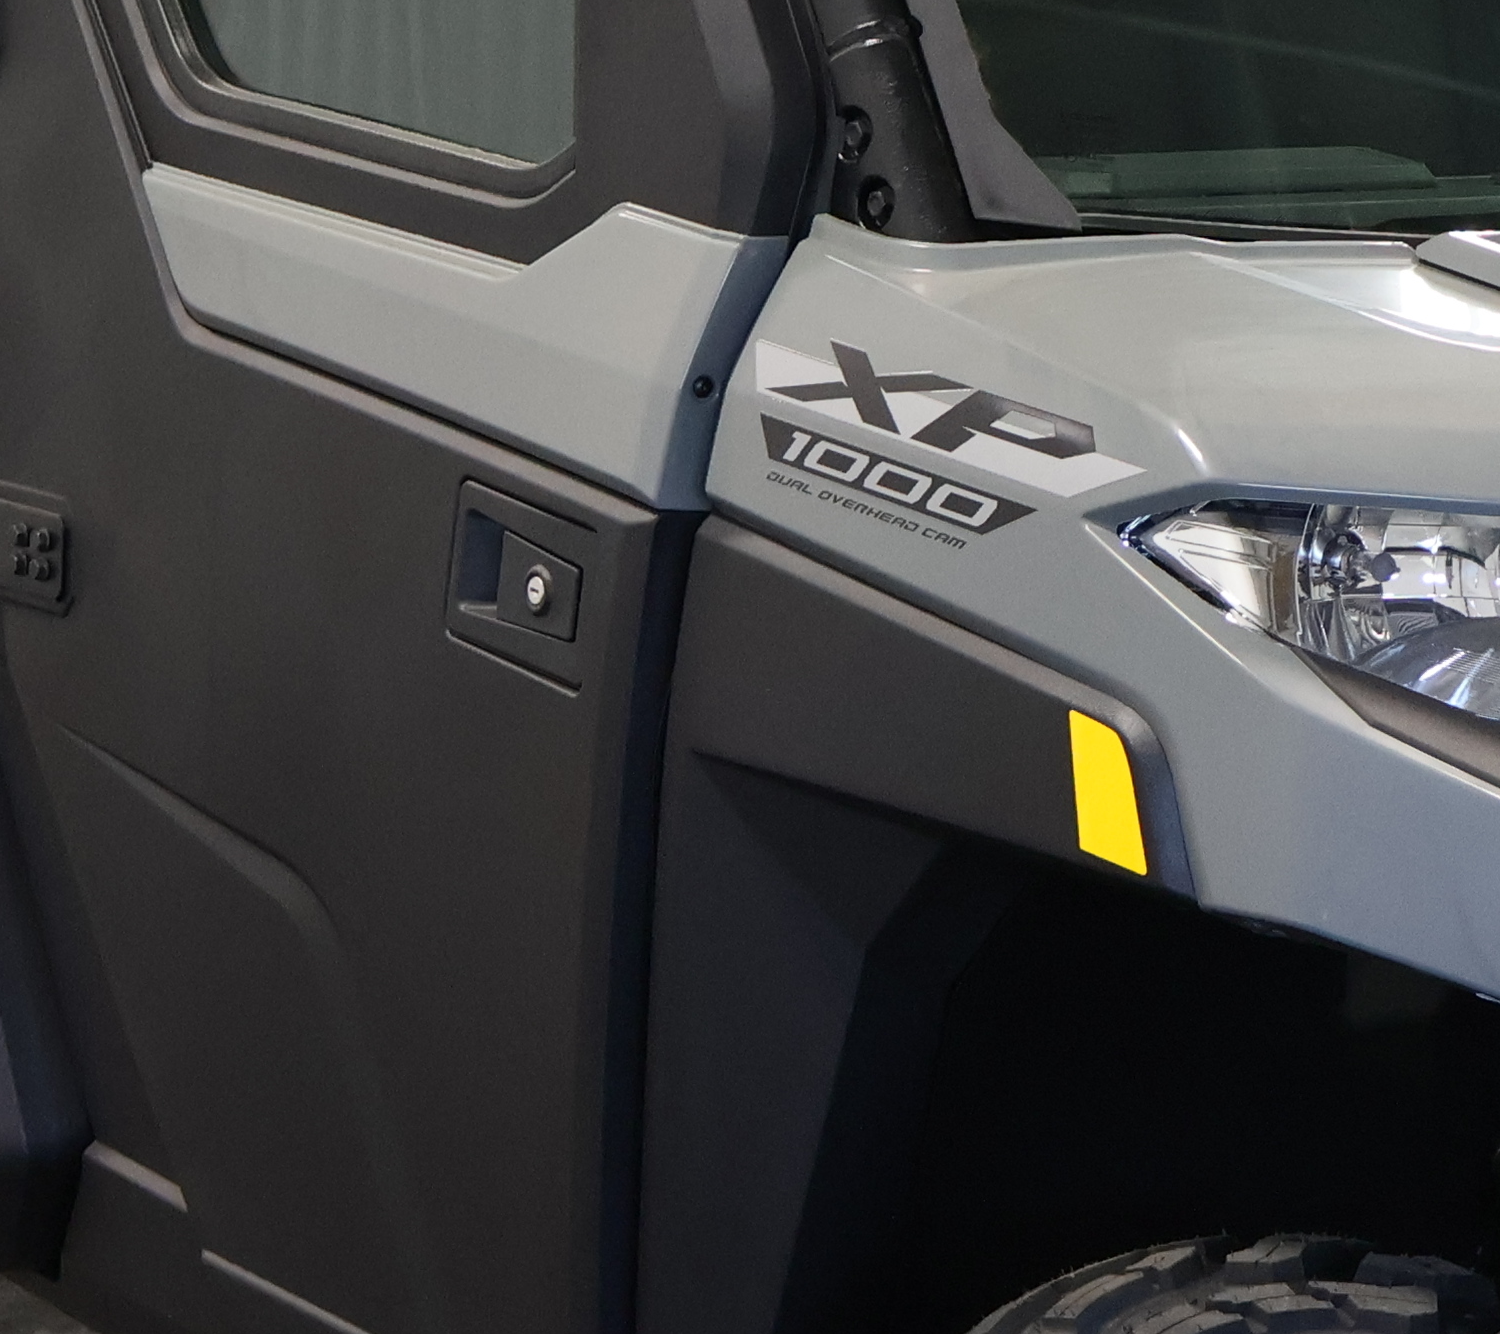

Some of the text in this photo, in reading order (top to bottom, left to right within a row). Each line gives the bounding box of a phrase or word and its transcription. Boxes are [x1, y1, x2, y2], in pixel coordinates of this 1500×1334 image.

[764, 339, 1096, 458] XP
[766, 471, 968, 550] DUAL OVERHEAD CAM
[781, 431, 999, 527] 1000
